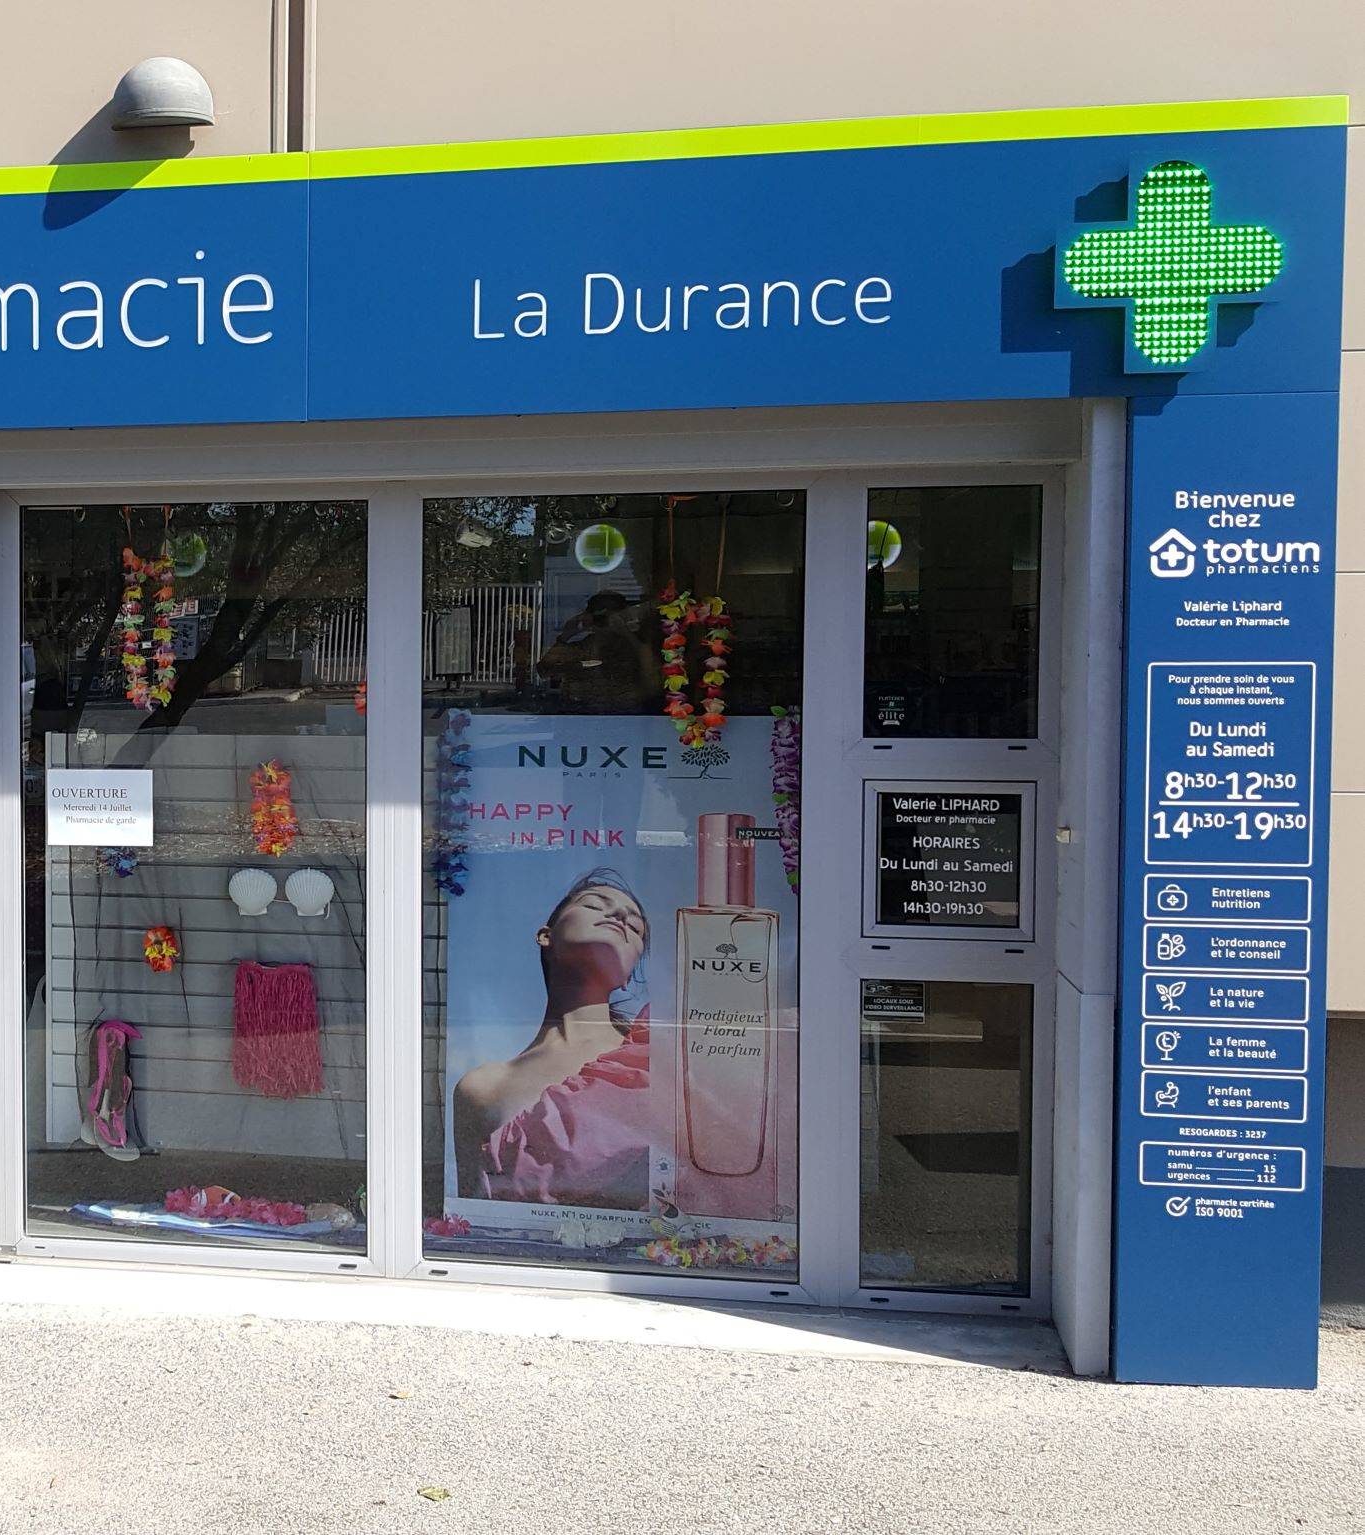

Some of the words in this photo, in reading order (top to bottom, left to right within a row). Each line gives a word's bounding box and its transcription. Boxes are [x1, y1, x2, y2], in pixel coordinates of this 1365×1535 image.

[474, 278, 547, 339] La
[584, 272, 892, 335] Durance
[1176, 491, 1295, 509] Bienvenue
[1209, 510, 1260, 528] chez
[1203, 539, 1320, 565] totum
[1207, 562, 1319, 576] pharmaciens
[1184, 601, 1228, 611] Valérie
[1233, 601, 1282, 613] Liphard
[1176, 618, 1217, 626] Docteur
[1236, 617, 1289, 626] Pharmacie
[1169, 675, 1191, 683] Pour
[1193, 675, 1231, 685] prendre
[1234, 675, 1254, 683] soin
[1257, 675, 1269, 683] de
[1190, 686, 1196, 694] à
[1199, 685, 1234, 696] chaque
[1237, 685, 1272, 695] instant,
[1248, 697, 1284, 705] ouverts
[1190, 722, 1212, 736] Du
[1218, 722, 1266, 737] Lundi
[1186, 745, 1206, 756] au
[1213, 742, 1274, 757] Samedi
[519, 746, 667, 769] NUXE
[1165, 772, 1296, 800] 8h30-12h30
[52, 788, 127, 798] OUVERTURE
[109, 804, 132, 812] Juillet
[893, 798, 936, 810] Valerie
[942, 799, 1000, 812] LIPHARD
[470, 804, 573, 821] HAPPY
[66, 816, 103, 824] Pharmacie
[105, 816, 114, 824] de
[116, 817, 136, 826] garde
[896, 814, 931, 823] Docteur
[949, 815, 996, 826] pharmacie
[1153, 811, 1306, 840] 14h30-19h30
[511, 832, 533, 844] IN
[547, 829, 624, 847] PINK
[913, 837, 980, 849] HORAIRES
[880, 858, 898, 869] Du
[903, 858, 938, 870] Lundi
[943, 861, 958, 871] au
[964, 860, 1013, 873] Samedi
[910, 880, 986, 893] 8h30-12h30
[1212, 888, 1270, 898] Entretiens
[903, 902, 983, 915] 14h30-19h30
[1212, 899, 1260, 908] nutrition
[1211, 938, 1287, 949] L'ordonnance
[1211, 949, 1222, 957] et
[1226, 949, 1236, 958] le
[1239, 950, 1280, 959] conseil
[692, 960, 761, 972] NUXE
[1210, 988, 1223, 996] La
[1227, 989, 1264, 998] nature
[1210, 999, 1220, 1007] et
[1225, 998, 1234, 1007] la
[1238, 999, 1254, 1008] vie
[689, 1009, 763, 1024] Prodigieux
[704, 1024, 746, 1037] Floral
[1209, 1037, 1222, 1046] La
[1226, 1037, 1266, 1047] femme
[691, 1041, 703, 1053] le
[707, 1043, 761, 1057] parfum
[1224, 1048, 1233, 1057] la
[1238, 1048, 1276, 1058] beauté
[1208, 1086, 1251, 1096] l'enfant
[1208, 1098, 1219, 1106] et
[1223, 1099, 1242, 1107] ses
[1246, 1100, 1289, 1109] parents
[1180, 1128, 1237, 1137] RESOGARDES
[1245, 1130, 1266, 1138] 3237
[1168, 1148, 1212, 1158] numéros
[1216, 1150, 1271, 1162] d'urgence
[1264, 1165, 1276, 1173] 15
[1257, 1175, 1276, 1183] 112
[1195, 1197, 1237, 1208] pharmacie
[1238, 1199, 1275, 1209] certifiée
[531, 1209, 559, 1219] NUXE,
[597, 1214, 635, 1223] PARFUM
[1196, 1208, 1213, 1217] ISO
[1217, 1208, 1243, 1218] 9001
